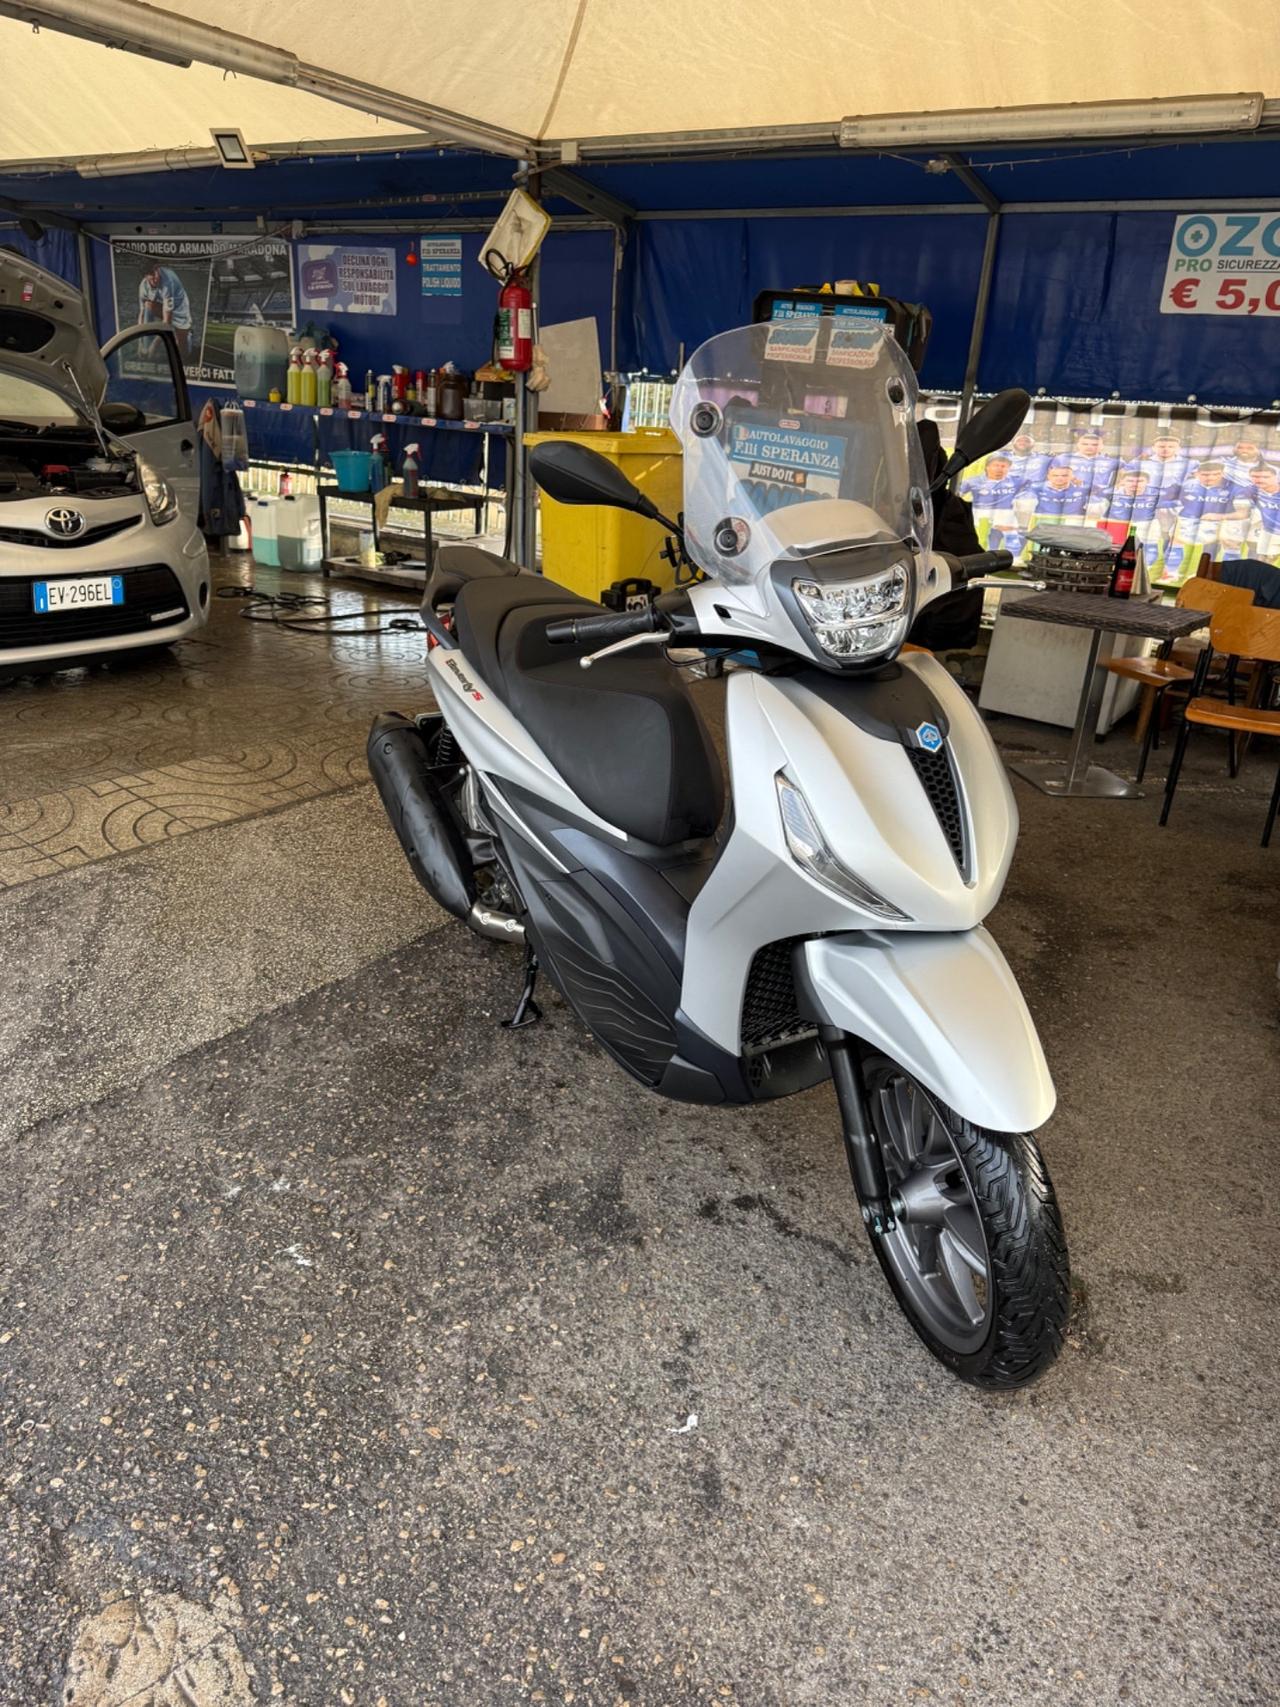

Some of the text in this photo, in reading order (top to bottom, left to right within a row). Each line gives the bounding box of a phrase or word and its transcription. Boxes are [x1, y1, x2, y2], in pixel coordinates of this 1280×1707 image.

[150, 242, 177, 254] DIEGO
[179, 243, 227, 255] ARMANDO
[343, 254, 389, 268] DECLINA OGNI
[1174, 258, 1214, 273] PRO
[356, 281, 389, 294] LAVAGGIO
[1169, 277, 1201, 310] €
[353, 294, 381, 306] MOTORI
[183, 365, 211, 379] VERCI
[213, 368, 235, 381] FATT
[749, 429, 829, 451] AUTOLAVAGGIO
[761, 445, 840, 470] SPERANZA
[751, 463, 771, 478] JUST
[771, 466, 785, 481] DO
